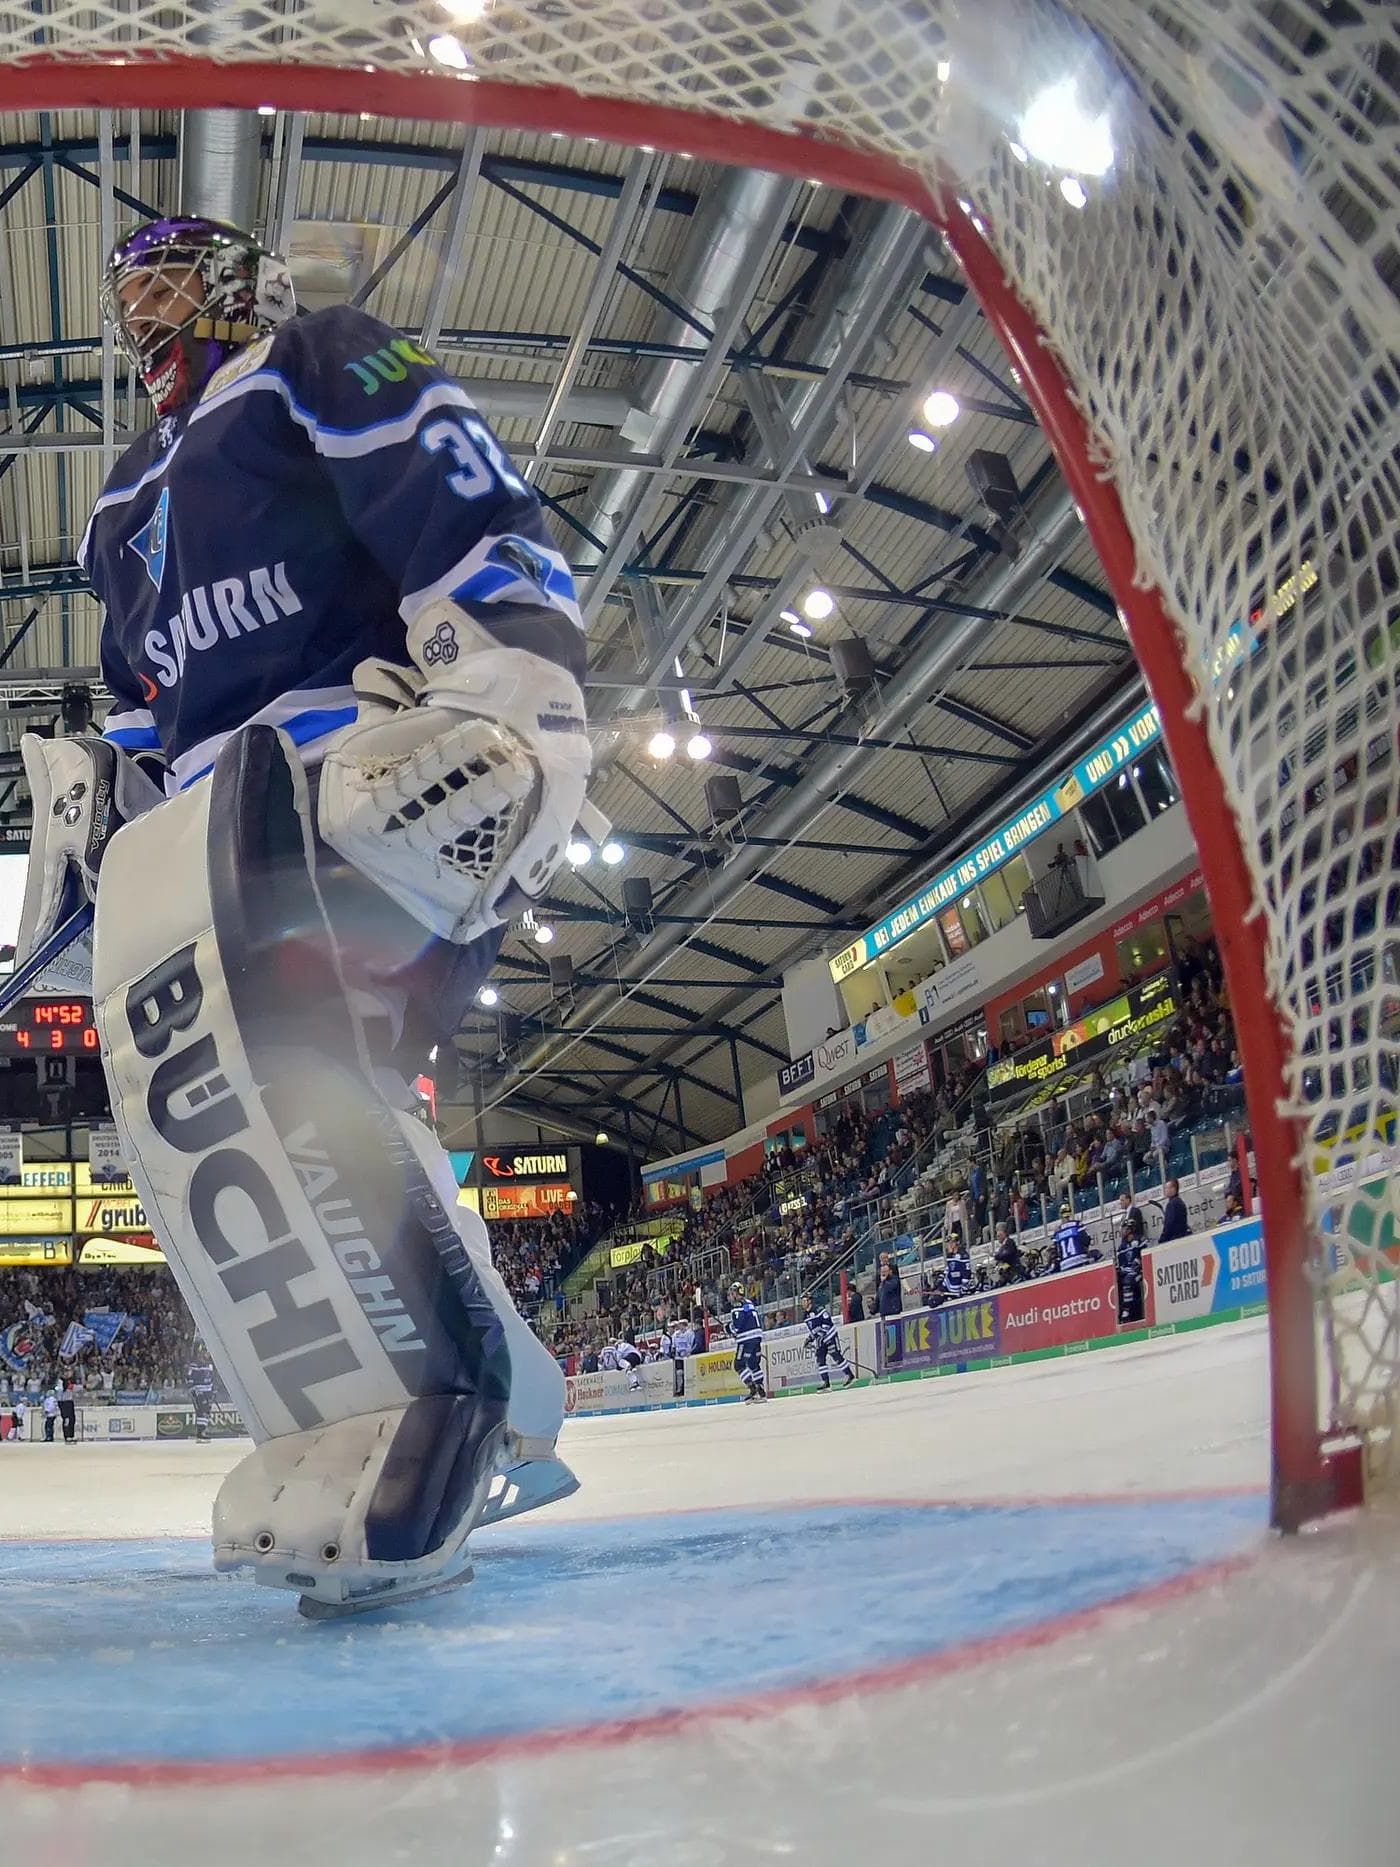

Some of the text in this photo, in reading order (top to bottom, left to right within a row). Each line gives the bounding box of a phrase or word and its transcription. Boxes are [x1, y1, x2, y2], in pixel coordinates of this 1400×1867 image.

[1085, 749, 1113, 783] UND
[5, 829, 31, 841] SATU
[874, 927, 890, 949] BEI
[891, 904, 920, 938] JEDEM
[918, 873, 959, 915] EINKAUF
[975, 838, 1005, 872] SPIEL
[1003, 801, 1052, 850] BRINGEN
[17, 1029, 96, 1048] 4 3 0
[97, 1149, 120, 1157] 2014
[513, 1155, 567, 1175] SATURN
[126, 942, 363, 1430] BÜCHL
[540, 1189, 564, 1203] LIVE
[101, 1205, 149, 1230] grub
[283, 1120, 427, 1353] VAUGHN
[1060, 1237, 1076, 1258] 14
[1157, 1258, 1198, 1287] SATURN
[1169, 1279, 1199, 1304] CARD
[938, 1302, 995, 1347] JUKE
[1005, 1297, 1100, 1329] Audi quattro
[708, 1360, 733, 1374] HOLIDAY
